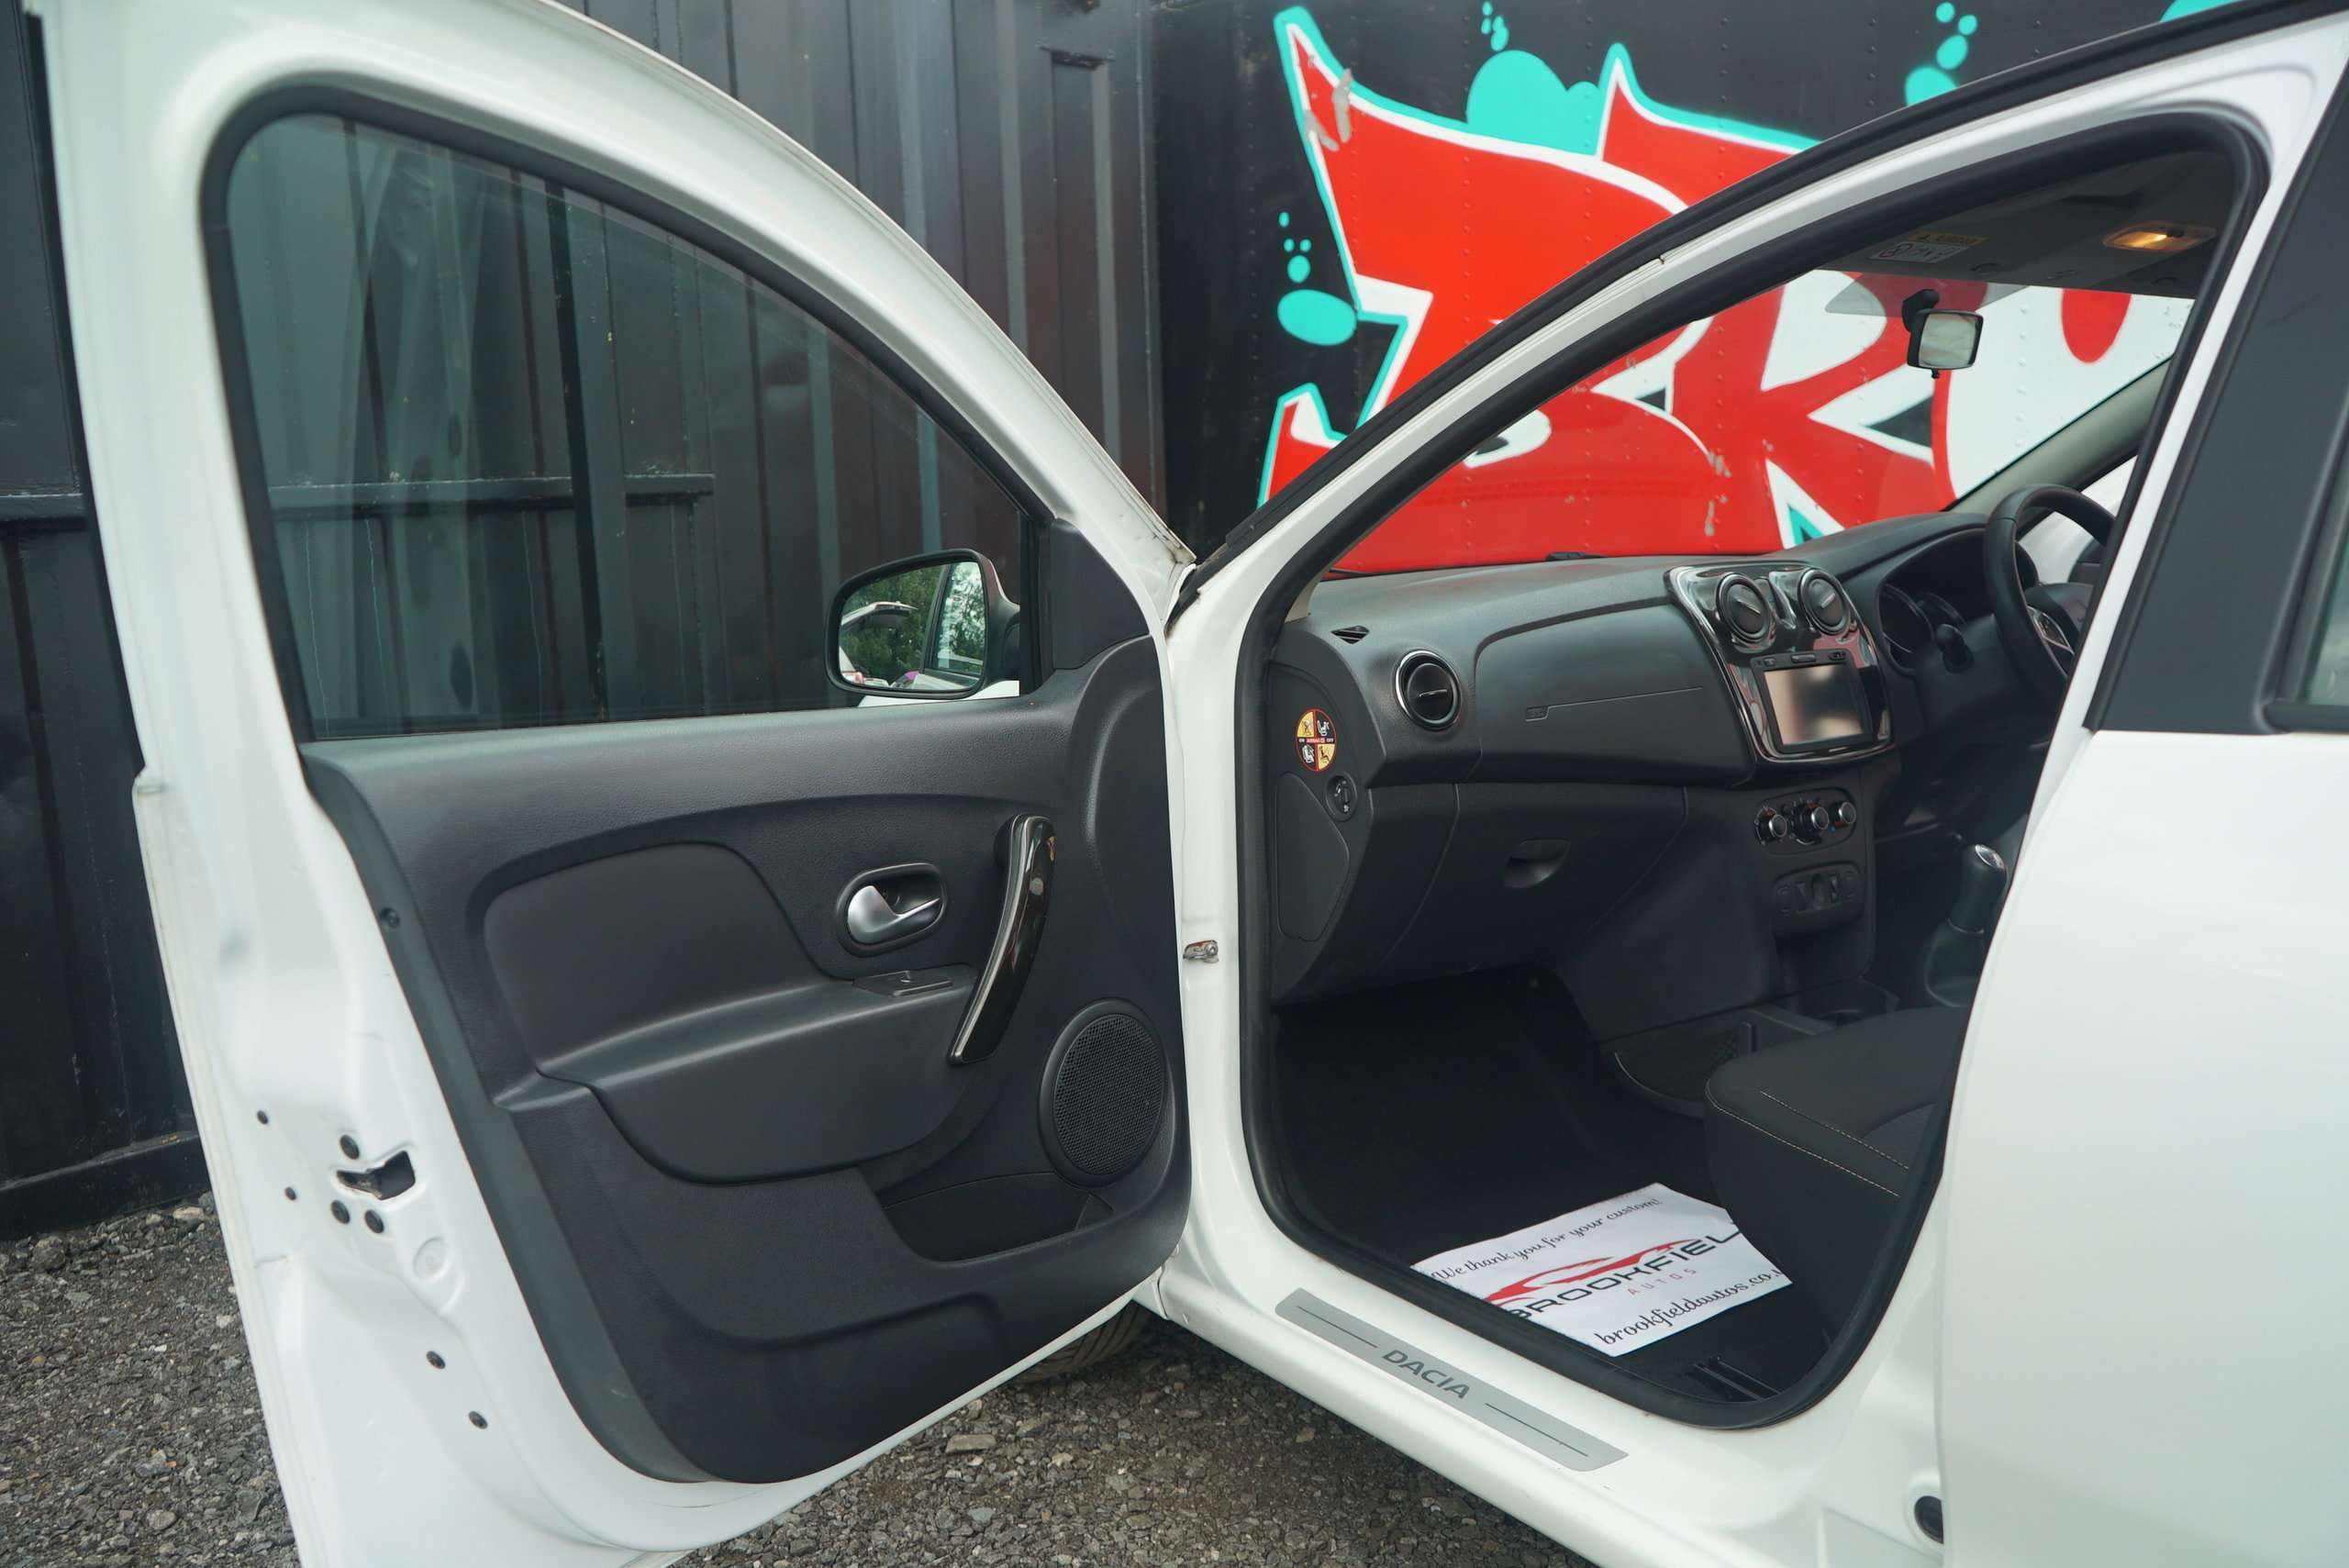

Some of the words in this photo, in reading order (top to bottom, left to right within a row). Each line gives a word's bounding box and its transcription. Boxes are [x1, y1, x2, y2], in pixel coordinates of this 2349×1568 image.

[1431, 1266, 1466, 1280] We
[1464, 1251, 1514, 1272] thank
[1513, 1242, 1545, 1261] you
[1542, 1233, 1566, 1249] for
[1568, 1218, 1604, 1239] your
[1627, 1267, 1697, 1296] AUTOS
[1381, 1349, 1470, 1399] DACIA
